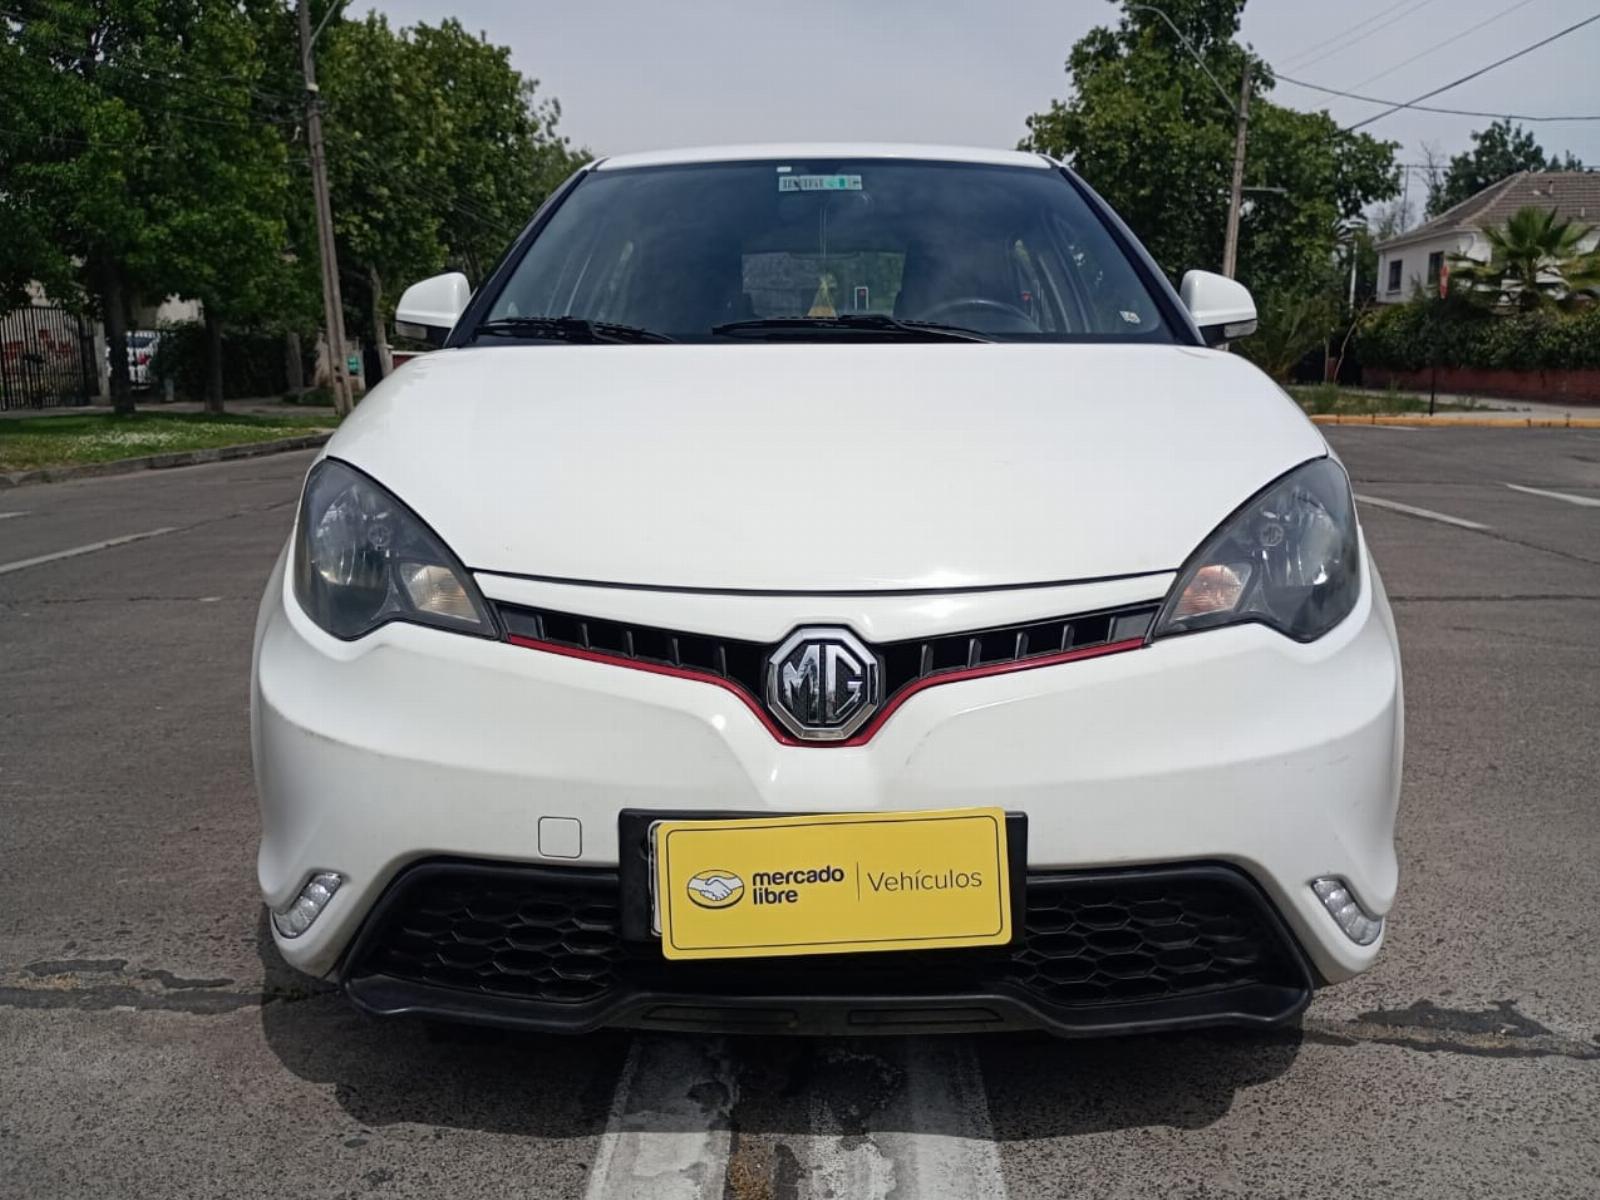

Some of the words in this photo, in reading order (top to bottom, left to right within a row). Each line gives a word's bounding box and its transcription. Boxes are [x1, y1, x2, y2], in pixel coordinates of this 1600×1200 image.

[782, 644, 864, 723] MG
[752, 866, 844, 886] mercado
[867, 870, 983, 892] Vehículos
[753, 887, 798, 905] libre
